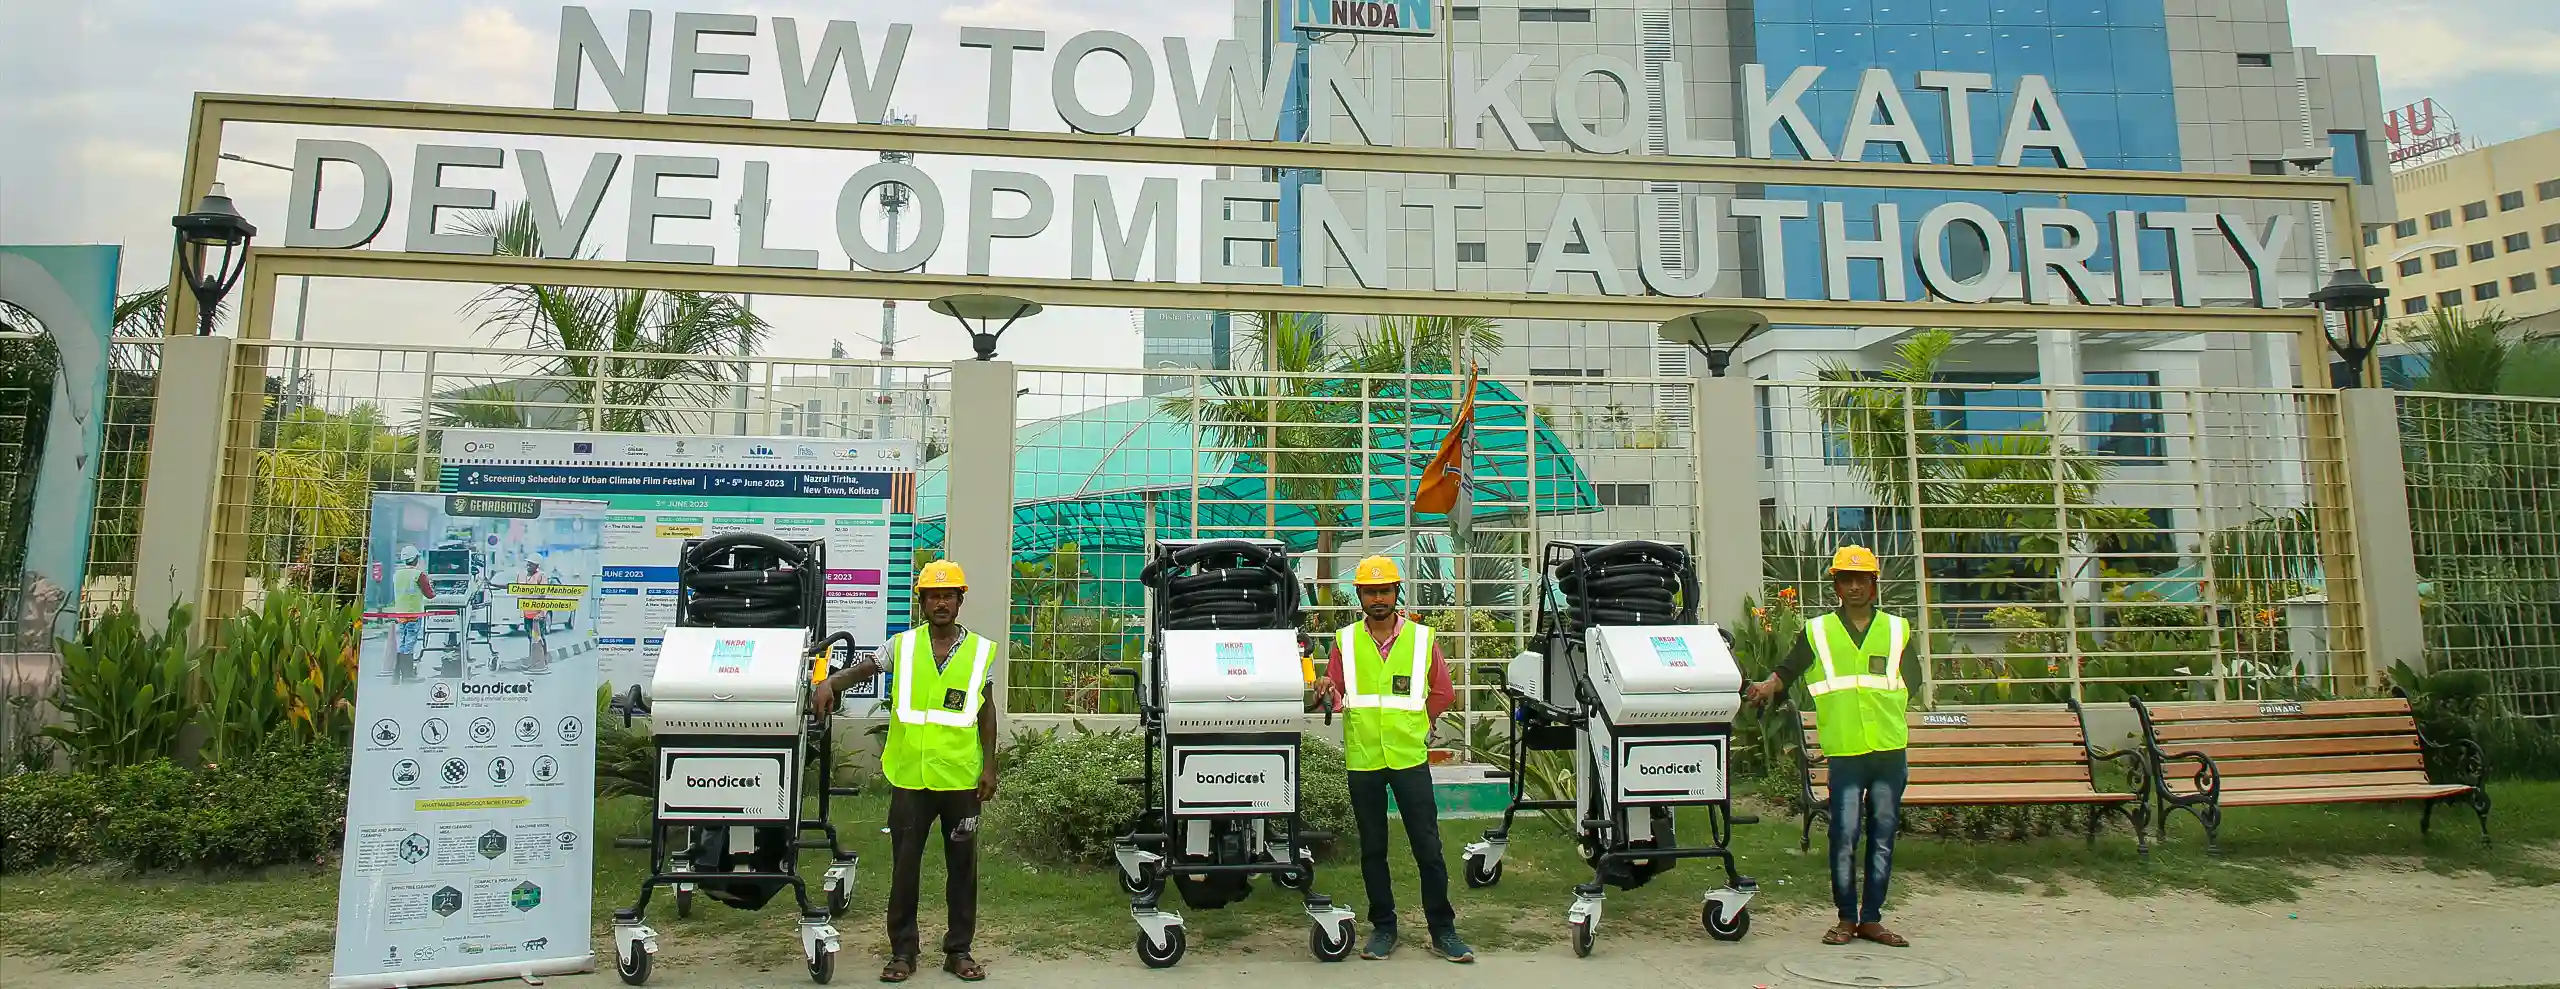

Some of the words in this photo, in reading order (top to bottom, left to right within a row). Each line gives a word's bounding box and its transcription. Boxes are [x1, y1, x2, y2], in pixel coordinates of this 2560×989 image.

[1332, 1, 1400, 28] NKDA
[553, 6, 912, 124] NEW
[960, 26, 1393, 146] TOWN
[1451, 50, 2088, 170] KOLKATA
[285, 138, 1483, 291] DEVELOPMENT
[1527, 192, 2294, 309] AUTHORITY
[483, 474, 526, 484] Screening
[528, 475, 566, 483] Schedule
[568, 475, 580, 484] for
[582, 476, 607, 484] Urban
[609, 476, 641, 485] Climate
[643, 477, 660, 485] Film
[663, 478, 695, 486] Festival
[714, 478, 725, 486] 3rd
[744, 478, 762, 487] June
[764, 479, 785, 487] 2023
[803, 474, 830, 483] Nazrul
[832, 475, 859, 484] Tirtha,
[803, 486, 821, 494] New
[823, 487, 847, 495] Town,
[848, 487, 879, 495] Kolkata
[470, 500, 533, 514] GENROBOTICS
[833, 573, 853, 581] 2023
[511, 585, 545, 595] Changing
[547, 586, 582, 595] Manholes
[461, 681, 533, 694] bandicoot
[2259, 705, 2301, 713] PRIMARC
[1923, 715, 1968, 723] PRIMARC
[1639, 761, 1702, 775] bandicoot
[687, 775, 761, 788] bandicoot
[1196, 771, 1265, 784] bandicoot
